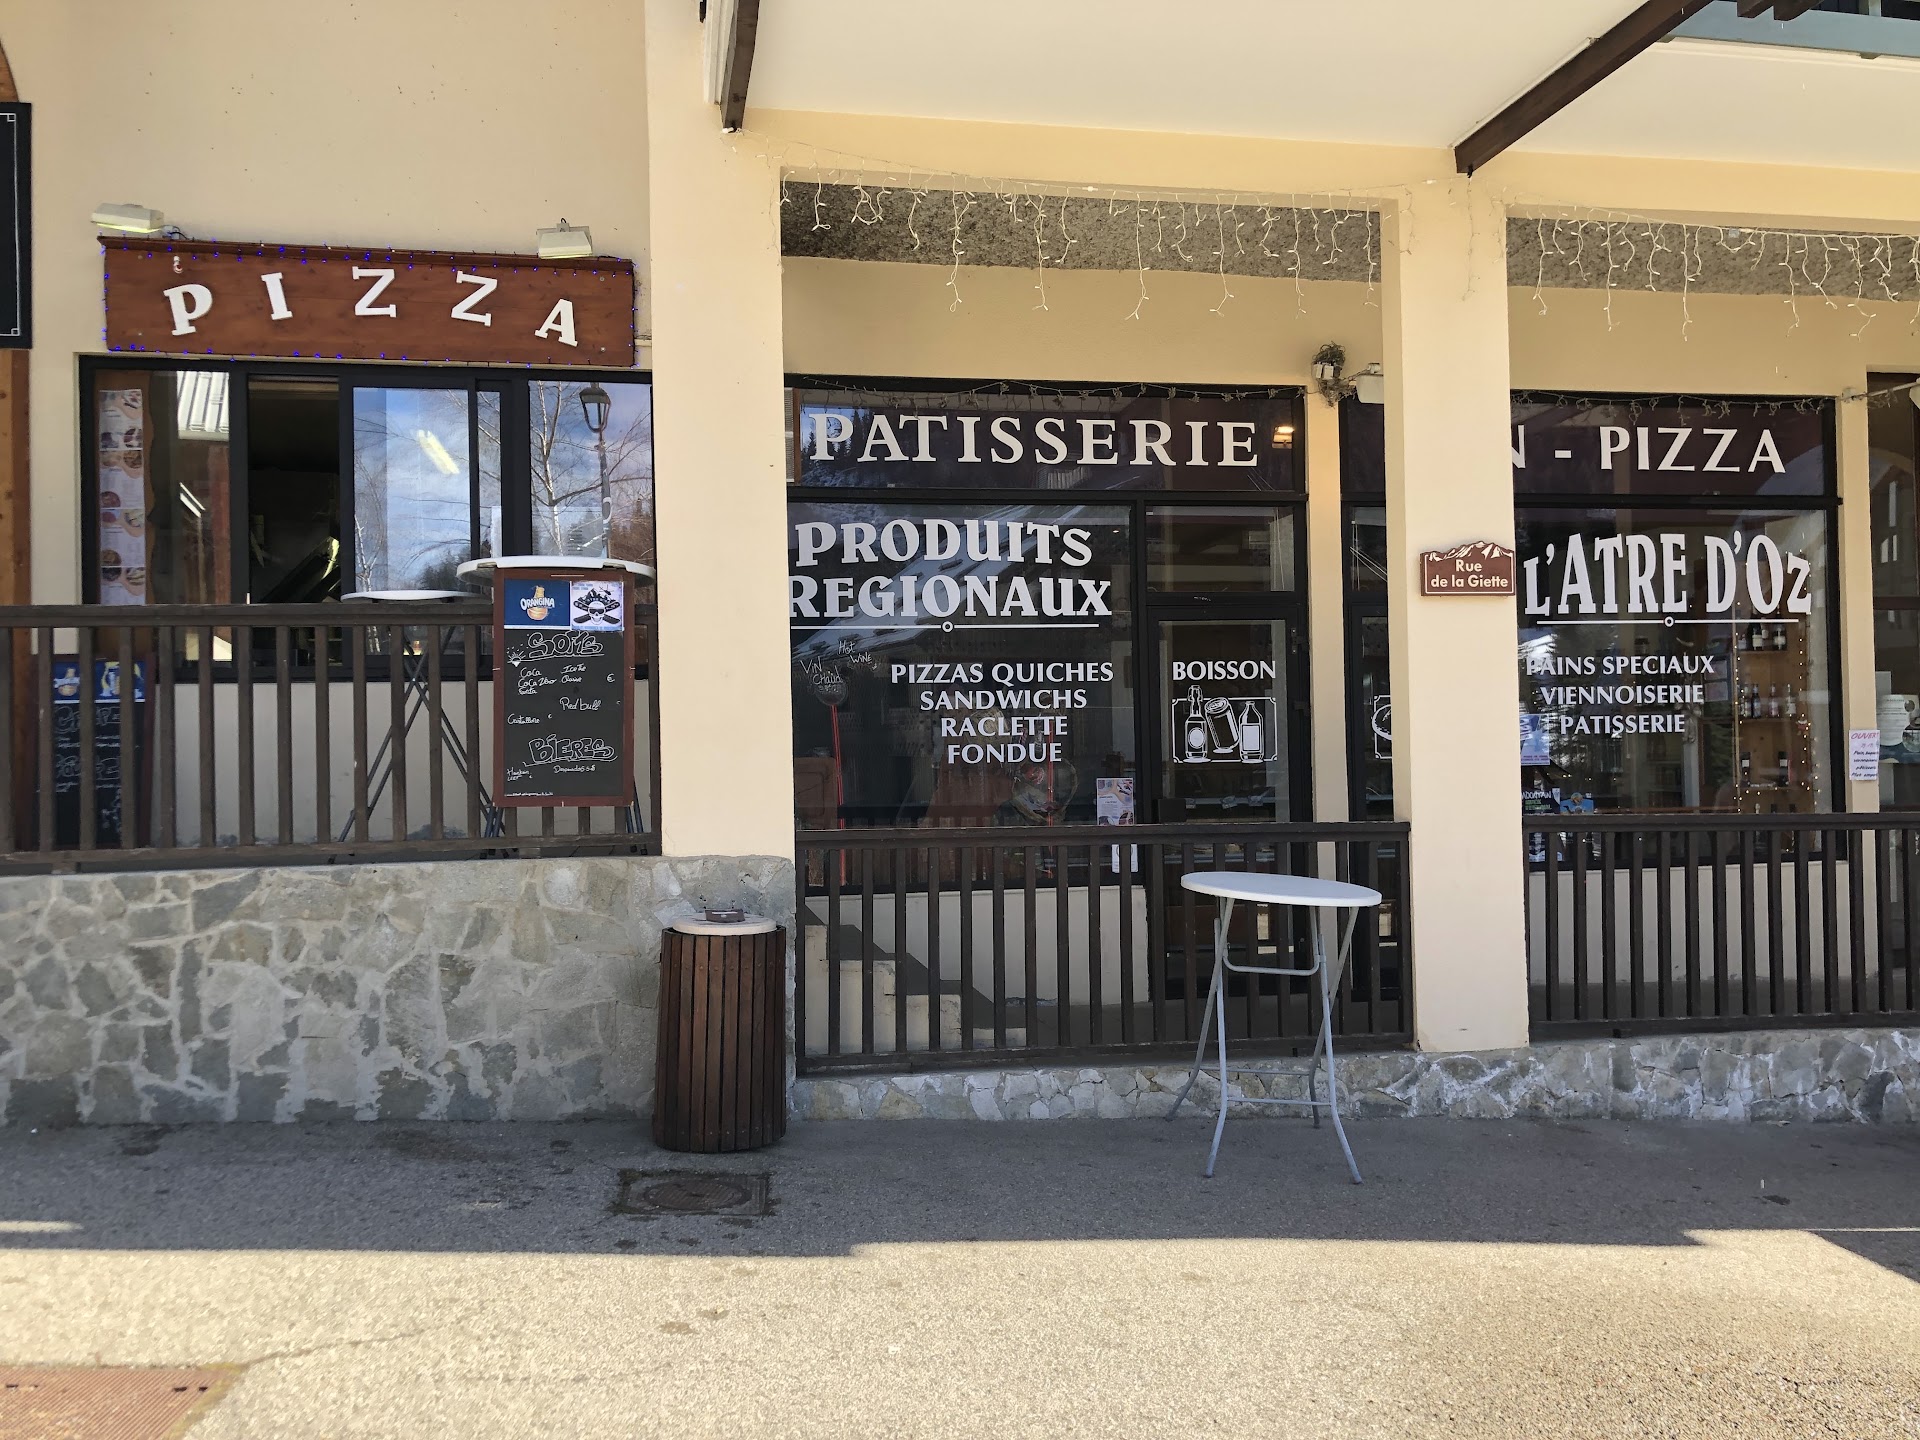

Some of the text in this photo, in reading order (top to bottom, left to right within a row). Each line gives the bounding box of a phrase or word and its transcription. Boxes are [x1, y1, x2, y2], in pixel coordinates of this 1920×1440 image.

[164, 267, 579, 347] PIZZA
[809, 413, 1259, 467] PATISSERIE
[1599, 426, 1786, 473] PIZZA
[795, 519, 1093, 567] PRODUITS
[1455, 559, 1483, 572] Rue
[1523, 533, 1689, 616] L'ATRE
[1430, 574, 1509, 588] de la Giette
[789, 574, 1112, 617] REGIONAUX
[891, 662, 1114, 688] PIZZAS QUICHES
[1172, 660, 1277, 681] BOISSON
[1526, 655, 1716, 676] PAINS SPECIAUX
[920, 688, 1088, 711] SANDWICHS
[1540, 684, 1705, 705] VIENNOISERIE
[941, 715, 1068, 737] RACLETTE
[1560, 714, 1686, 735] PATISSERIE
[948, 742, 1062, 764] FONDUE
